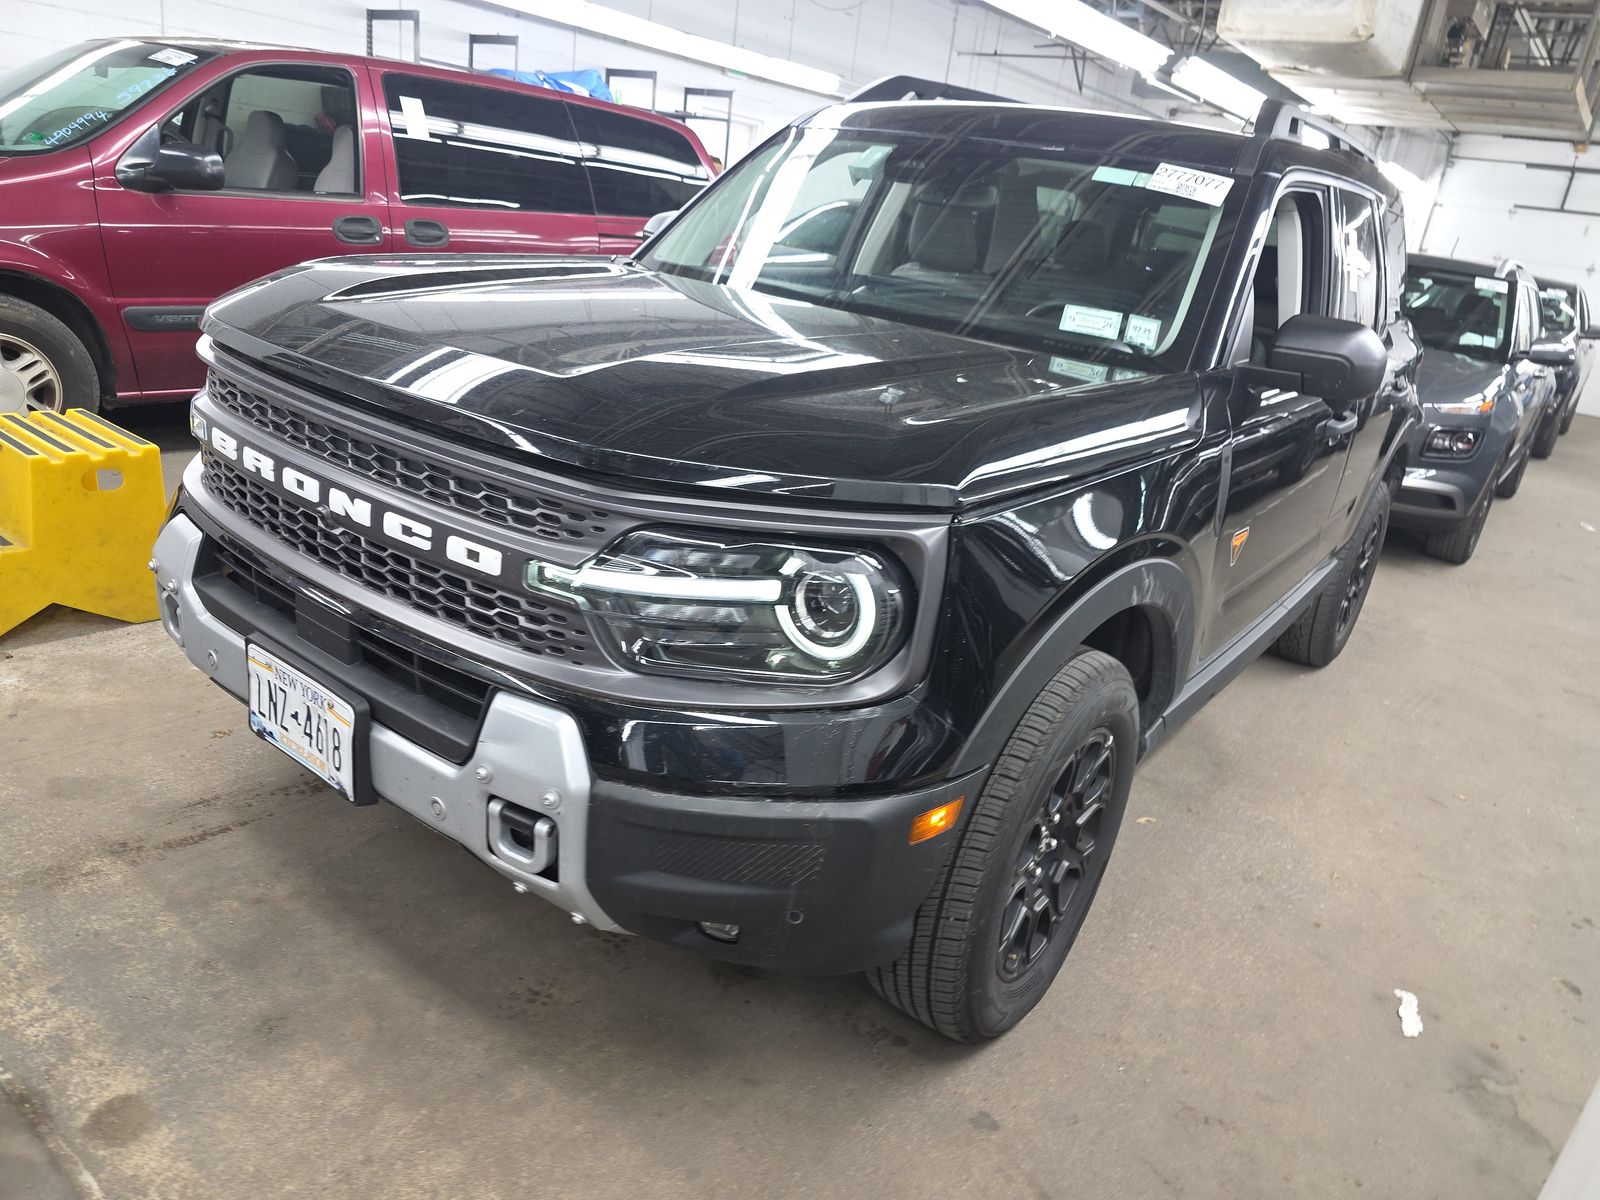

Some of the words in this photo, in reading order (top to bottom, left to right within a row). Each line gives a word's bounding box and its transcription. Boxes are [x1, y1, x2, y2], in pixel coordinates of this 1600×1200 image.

[44, 110, 109, 145] 4904994
[1156, 166, 1225, 190] 2777077
[211, 426, 503, 576] BRONCO
[274, 666, 298, 691] NEW
[301, 683, 328, 713] YORK
[255, 672, 289, 732] LNZ
[303, 702, 342, 772] 4618
